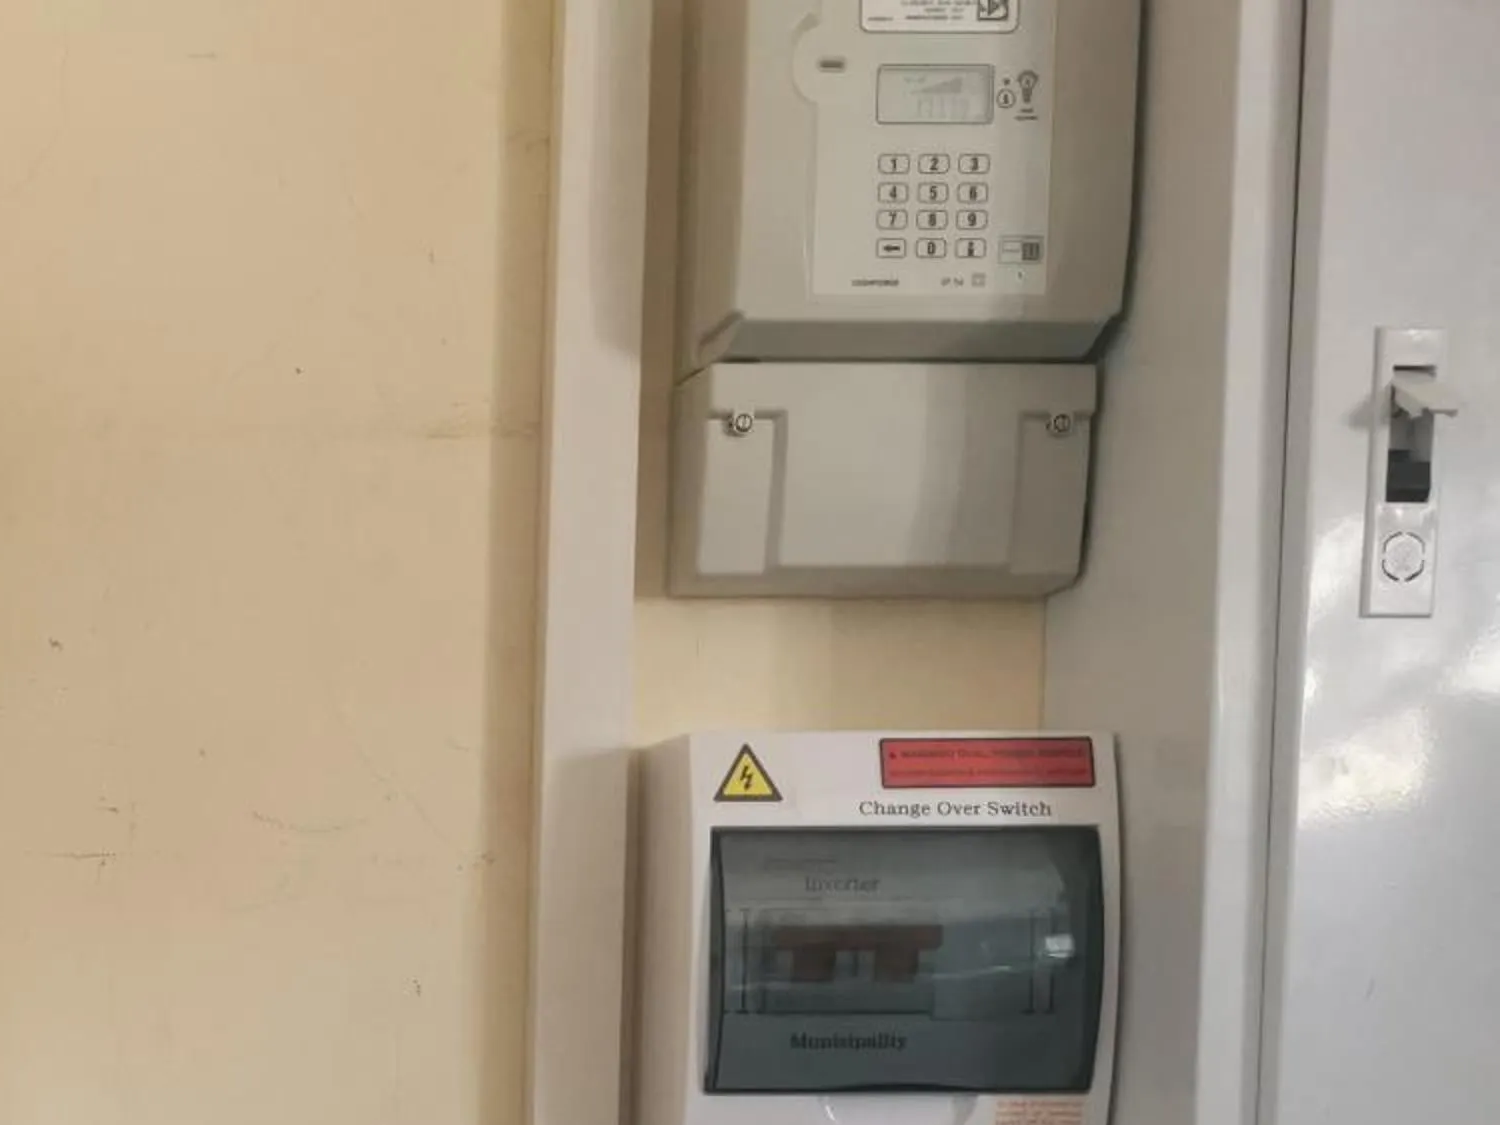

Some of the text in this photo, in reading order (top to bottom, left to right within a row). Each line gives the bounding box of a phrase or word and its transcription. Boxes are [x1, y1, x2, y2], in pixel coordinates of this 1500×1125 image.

[929, 157, 939, 171] 2
[929, 185, 938, 200] 5
[967, 212, 977, 227] 9
[859, 801, 1053, 818] Change Over Switch
